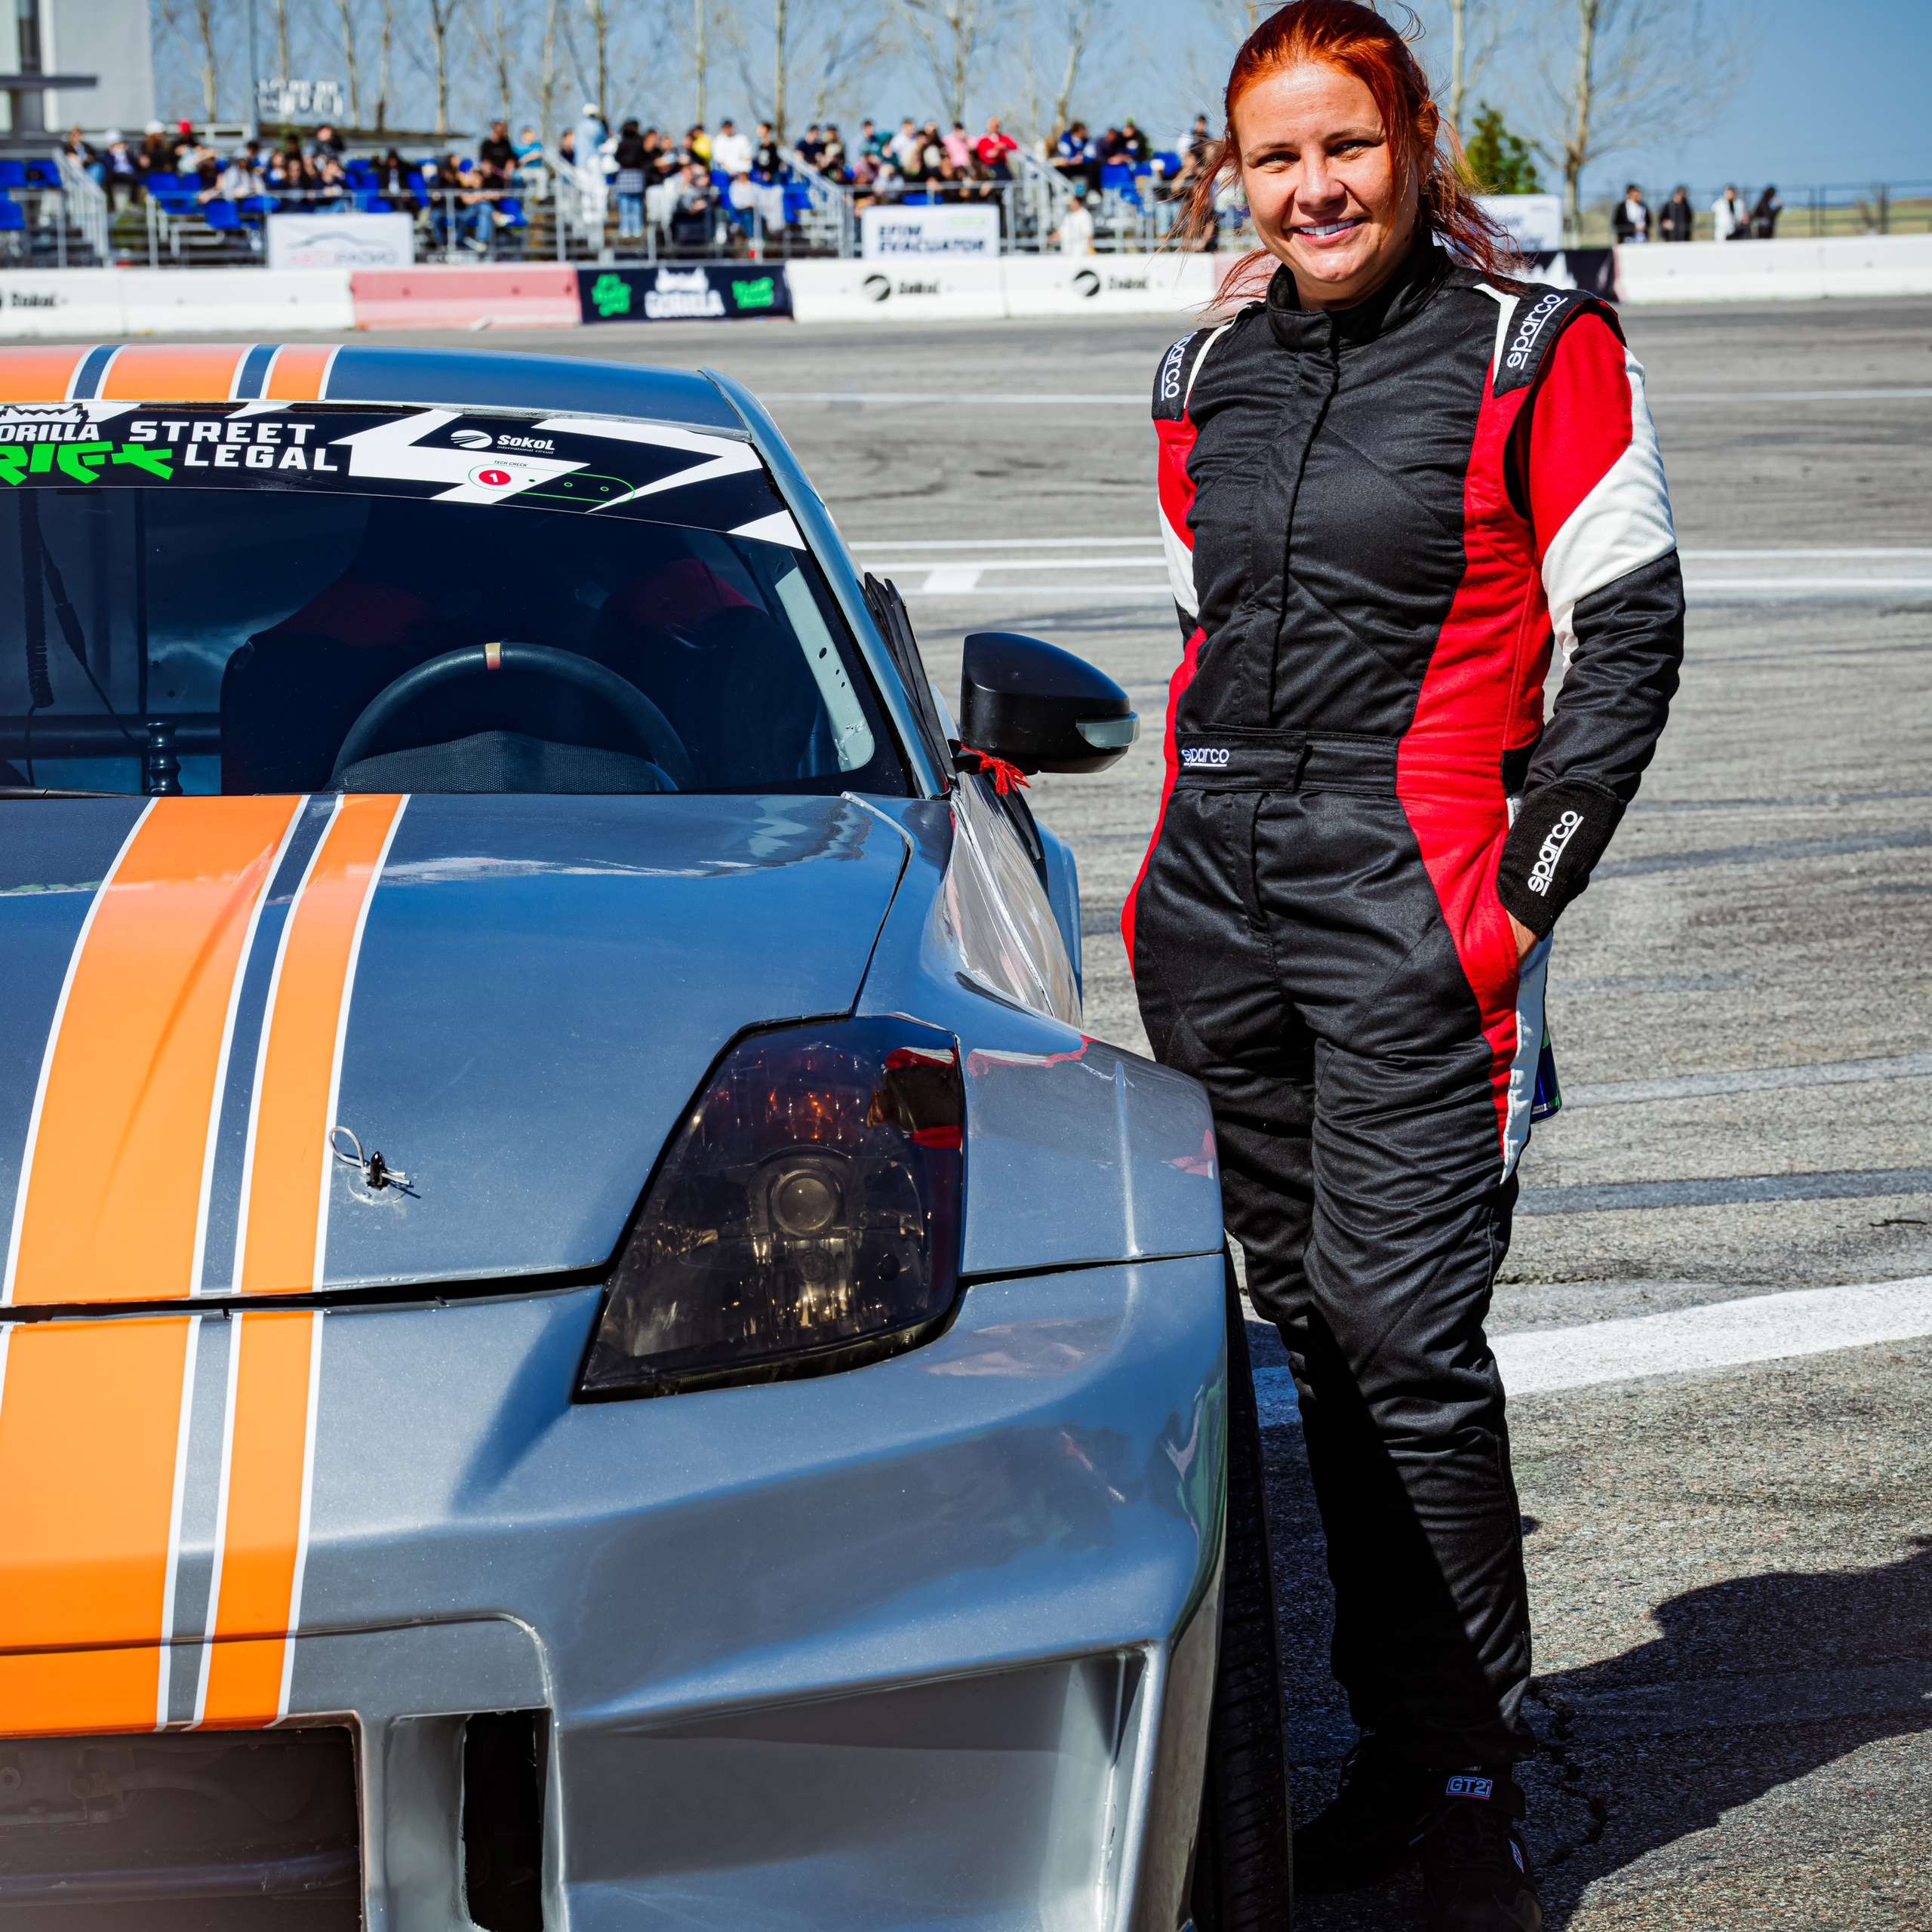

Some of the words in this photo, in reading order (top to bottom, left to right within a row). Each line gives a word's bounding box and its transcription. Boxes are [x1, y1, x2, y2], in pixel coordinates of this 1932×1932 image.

[645, 290, 725, 318] GORILLA
[1506, 294, 1568, 370] sparco
[128, 420, 315, 445] STREET
[184, 443, 338, 471] LEGAL
[489, 472, 499, 483] 1
[1181, 748, 1229, 767] sparco
[1527, 811, 1584, 897] sparco
[1449, 1777, 1491, 1795] GT2i
